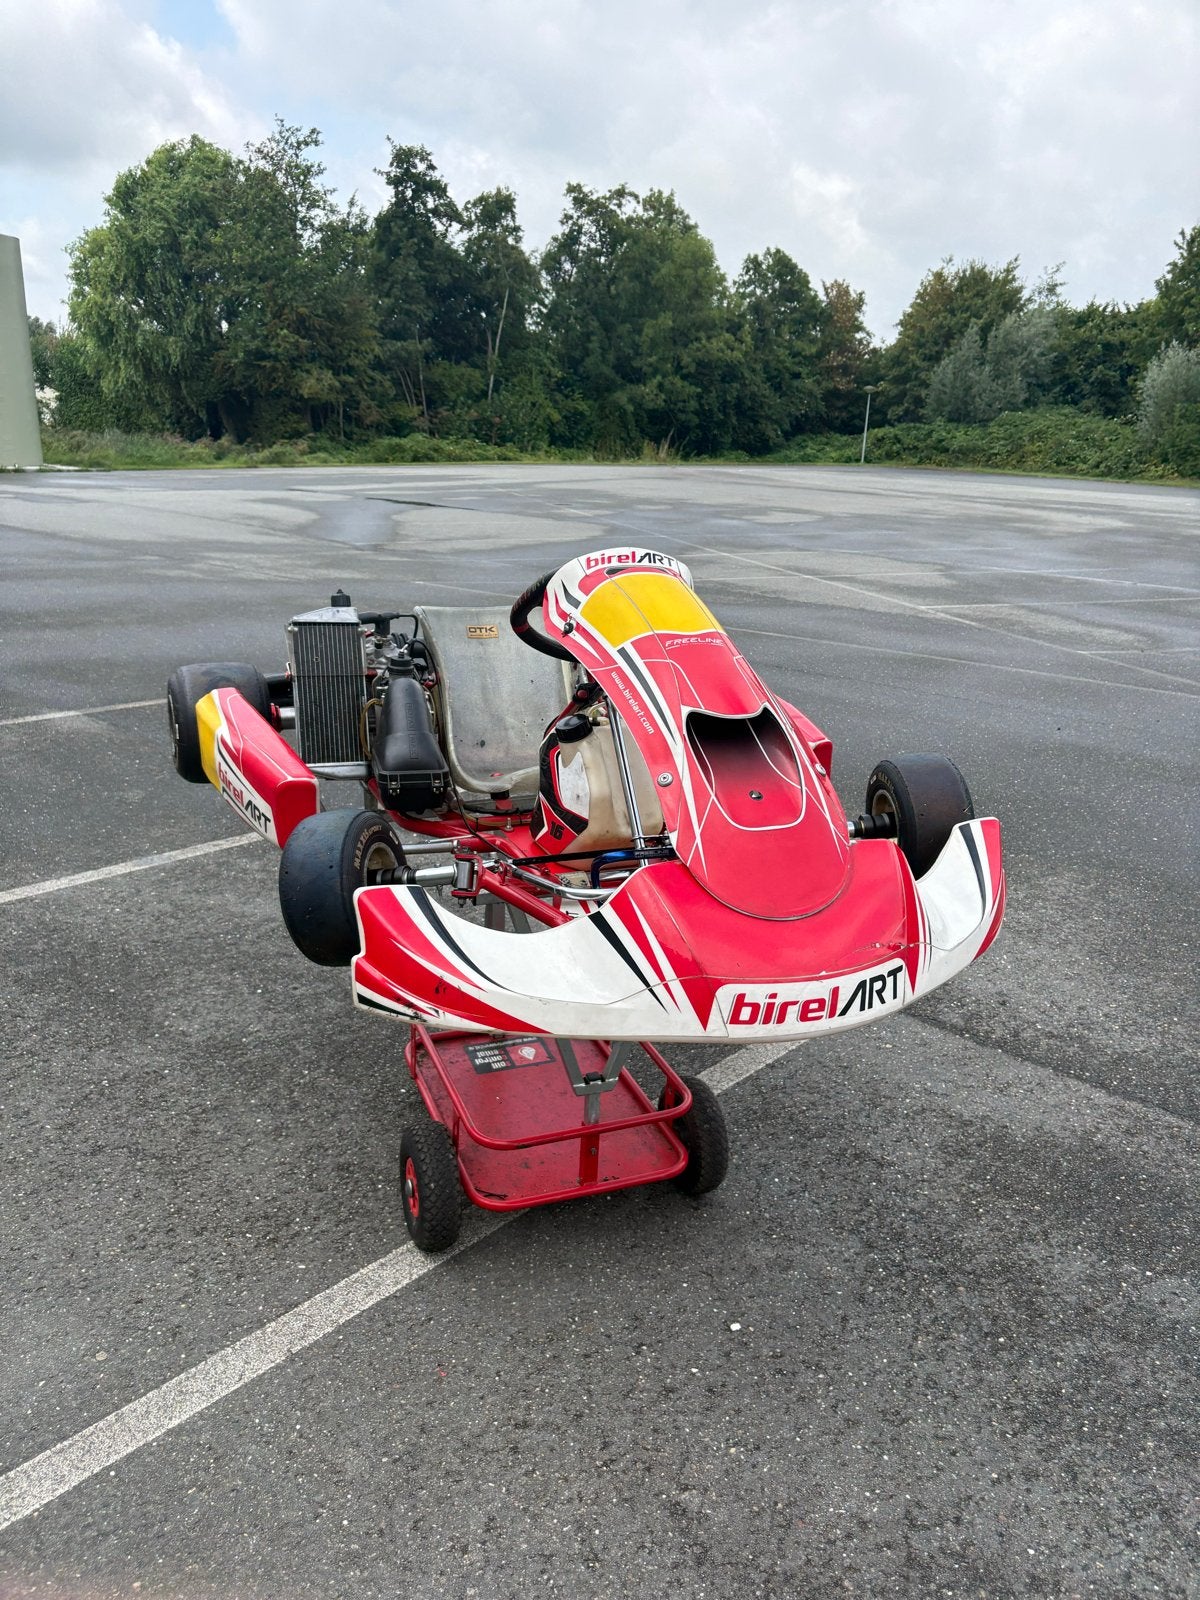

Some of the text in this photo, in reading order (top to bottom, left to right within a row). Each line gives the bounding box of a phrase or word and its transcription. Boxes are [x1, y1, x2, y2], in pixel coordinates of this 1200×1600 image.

[585, 551, 675, 570] birelART
[468, 626, 496, 634] OTK
[665, 637, 723, 647] FREELINE
[611, 671, 655, 735] www.birelart.com
[218, 762, 272, 834] birelART
[726, 965, 903, 1025] birelART
